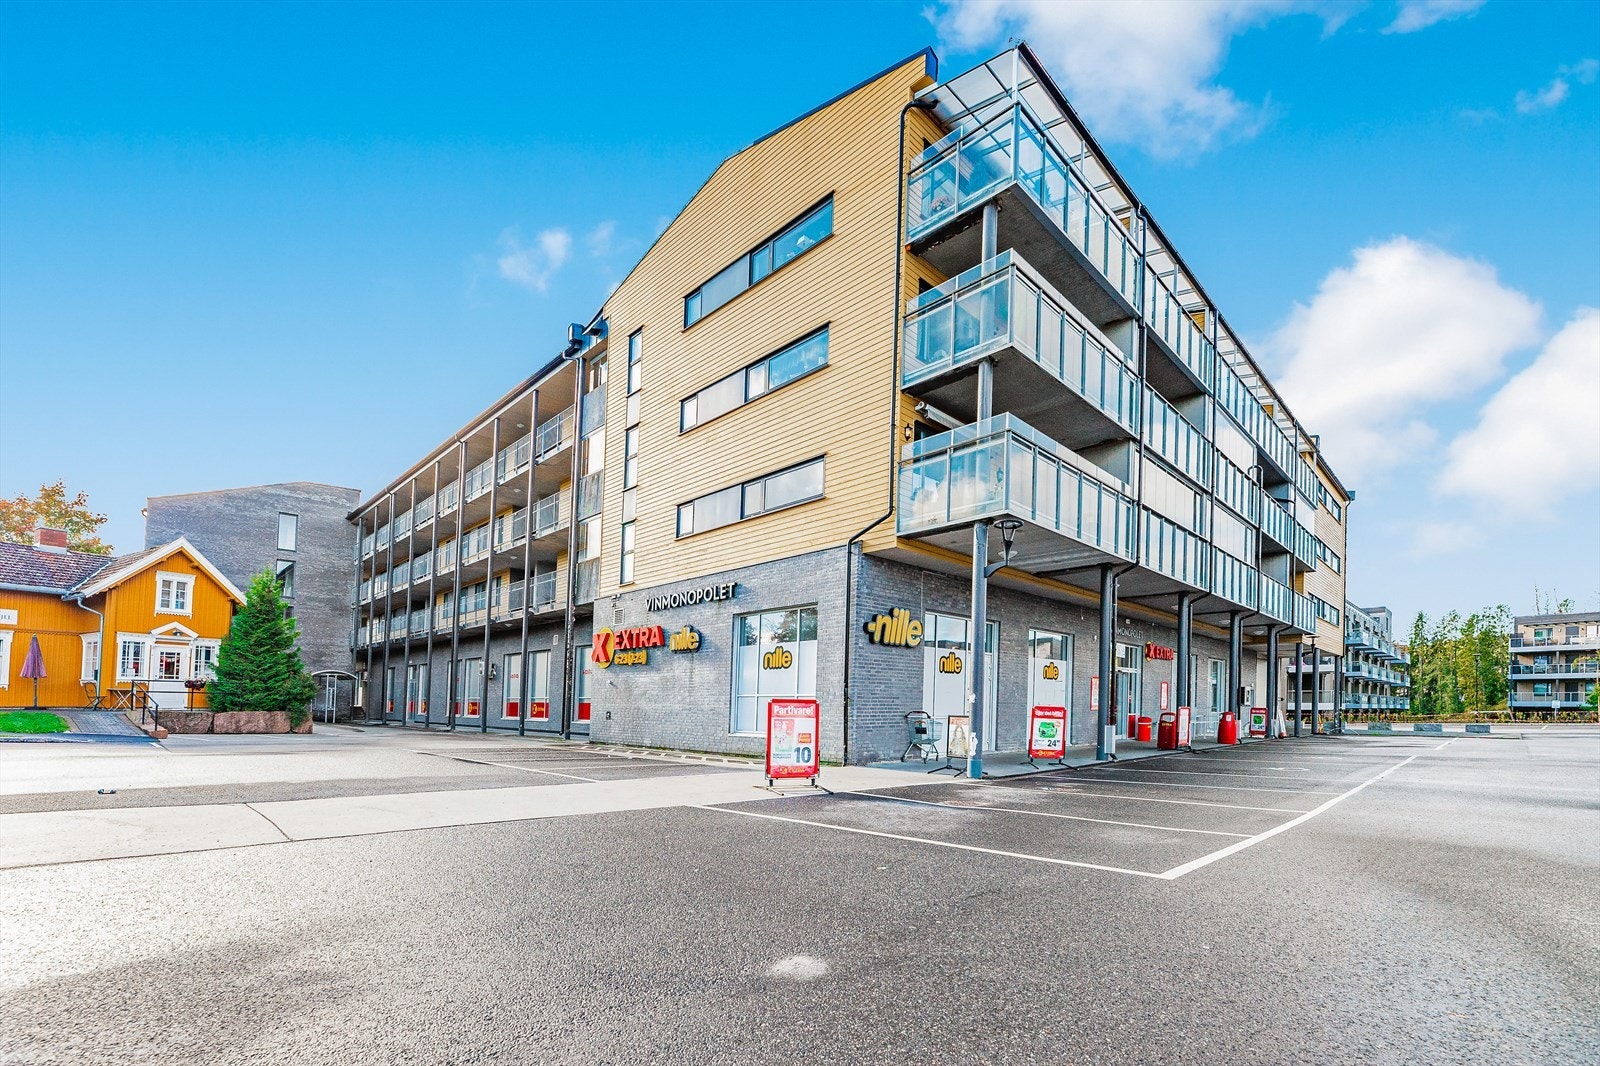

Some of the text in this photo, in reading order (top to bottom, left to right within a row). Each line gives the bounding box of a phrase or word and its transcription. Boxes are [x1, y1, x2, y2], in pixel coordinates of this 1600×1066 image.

[645, 582, 737, 611] VINMONOPOLET
[614, 626, 664, 650] EXTRA
[669, 625, 701, 653] nille
[763, 646, 792, 670] nille
[1156, 645, 1174, 660] EXTRA
[939, 652, 962, 674] nille
[1043, 662, 1059, 680] nille
[773, 705, 814, 716] Partivare!
[1047, 739, 1057, 747] 24
[794, 746, 812, 764] 10
